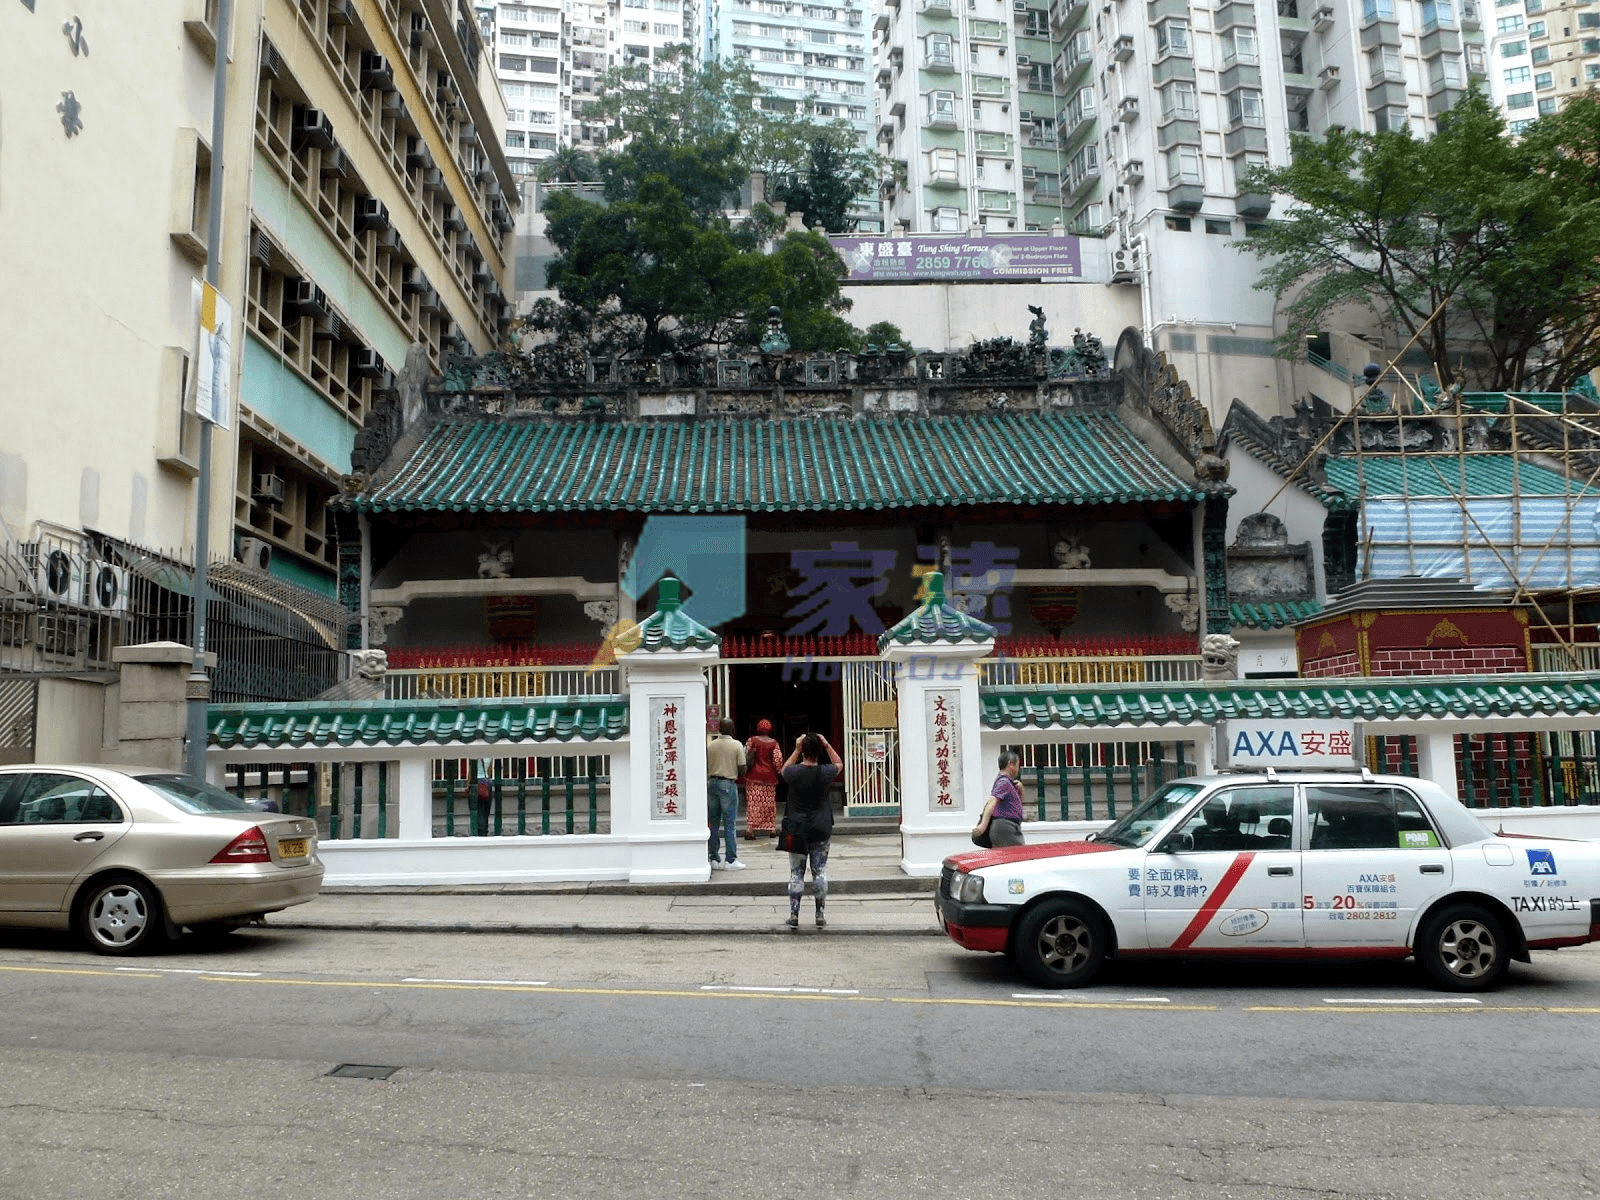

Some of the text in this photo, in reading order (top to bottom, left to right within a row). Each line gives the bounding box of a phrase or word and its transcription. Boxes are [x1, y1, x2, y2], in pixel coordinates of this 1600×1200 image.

[917, 243, 989, 254] Tung Shing Terrace
[916, 256, 950, 269] 2859
[954, 256, 989, 269] 7766
[1232, 730, 1352, 756] AXA安盛
[1346, 912, 1370, 920] 2802
[1373, 912, 1397, 920] 2812
